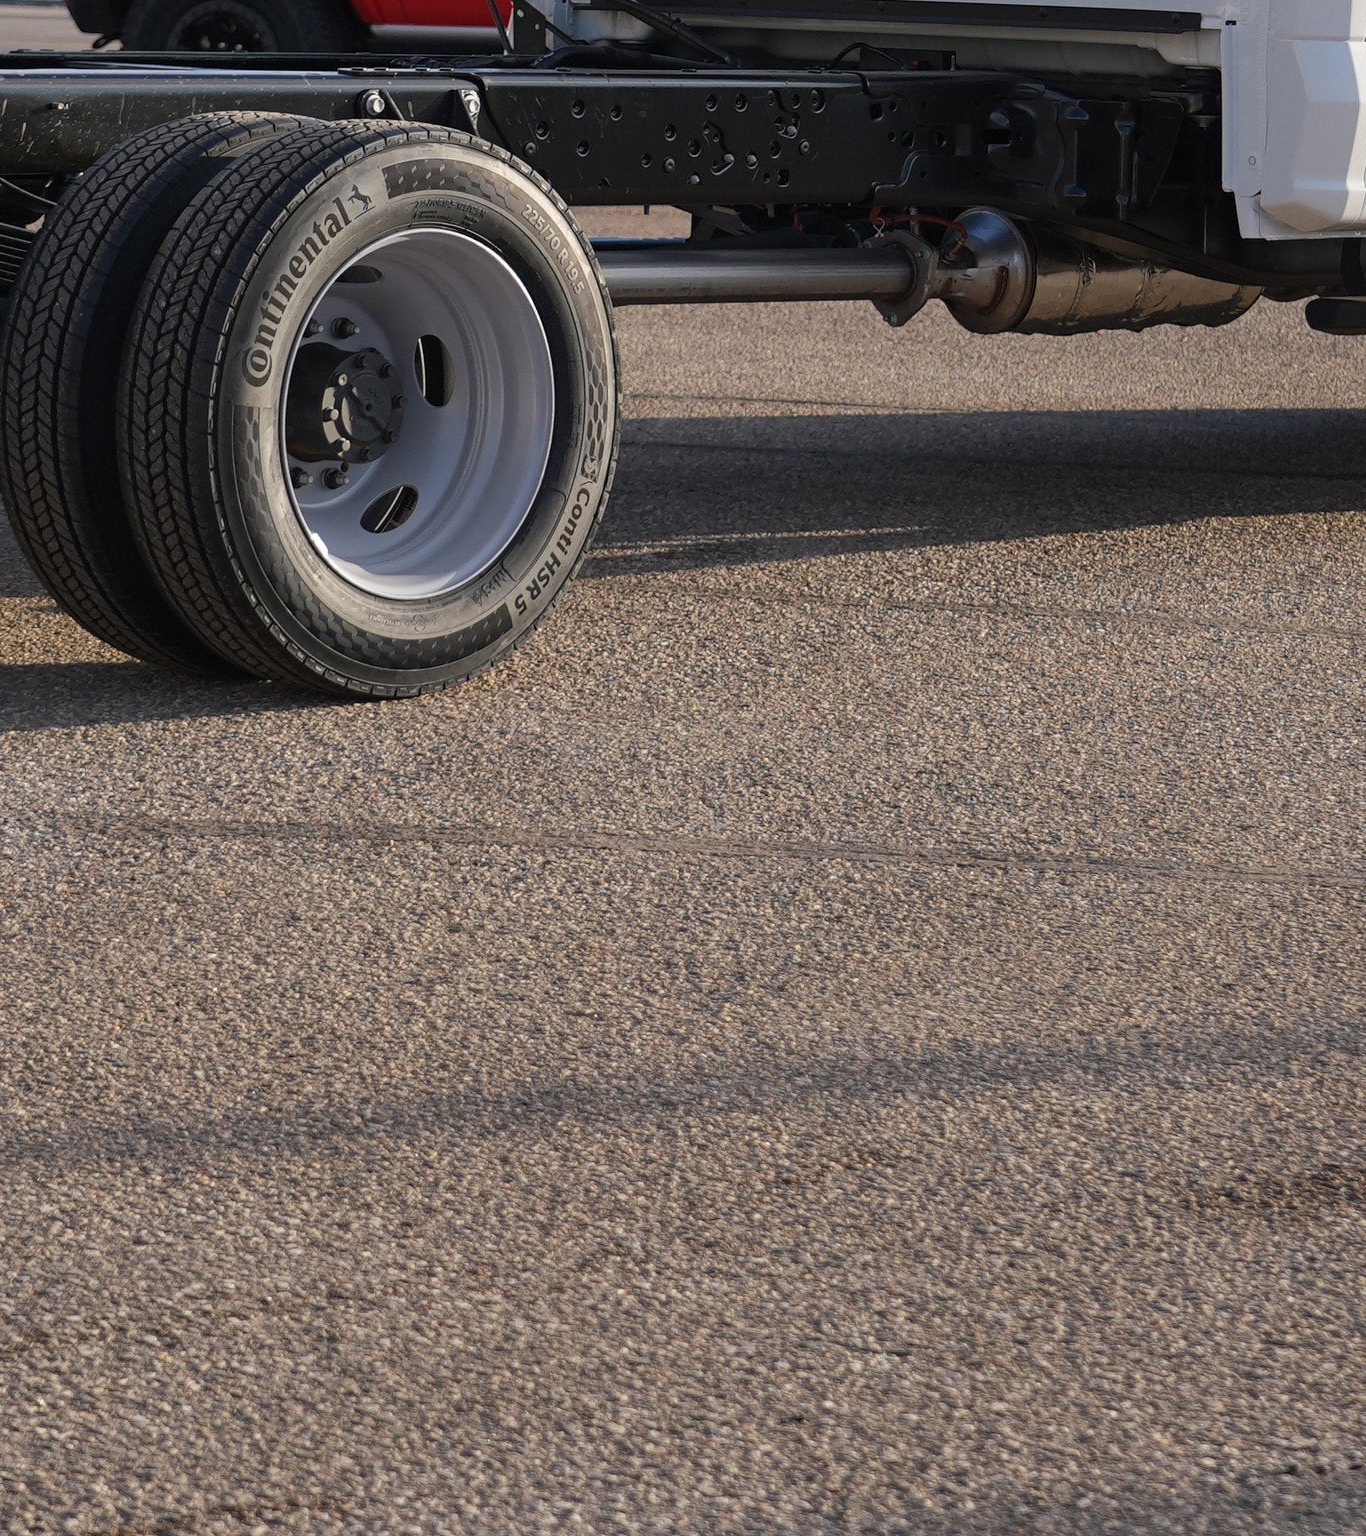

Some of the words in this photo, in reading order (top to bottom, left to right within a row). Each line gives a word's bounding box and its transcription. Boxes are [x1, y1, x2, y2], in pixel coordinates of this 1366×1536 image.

[521, 204, 561, 251] 225/70
[557, 252, 569, 266] R
[564, 263, 585, 295] 19.5
[241, 196, 353, 387] Continental
[556, 488, 590, 555] Conti
[514, 593, 528, 616] 5
[525, 552, 561, 601] HSR
